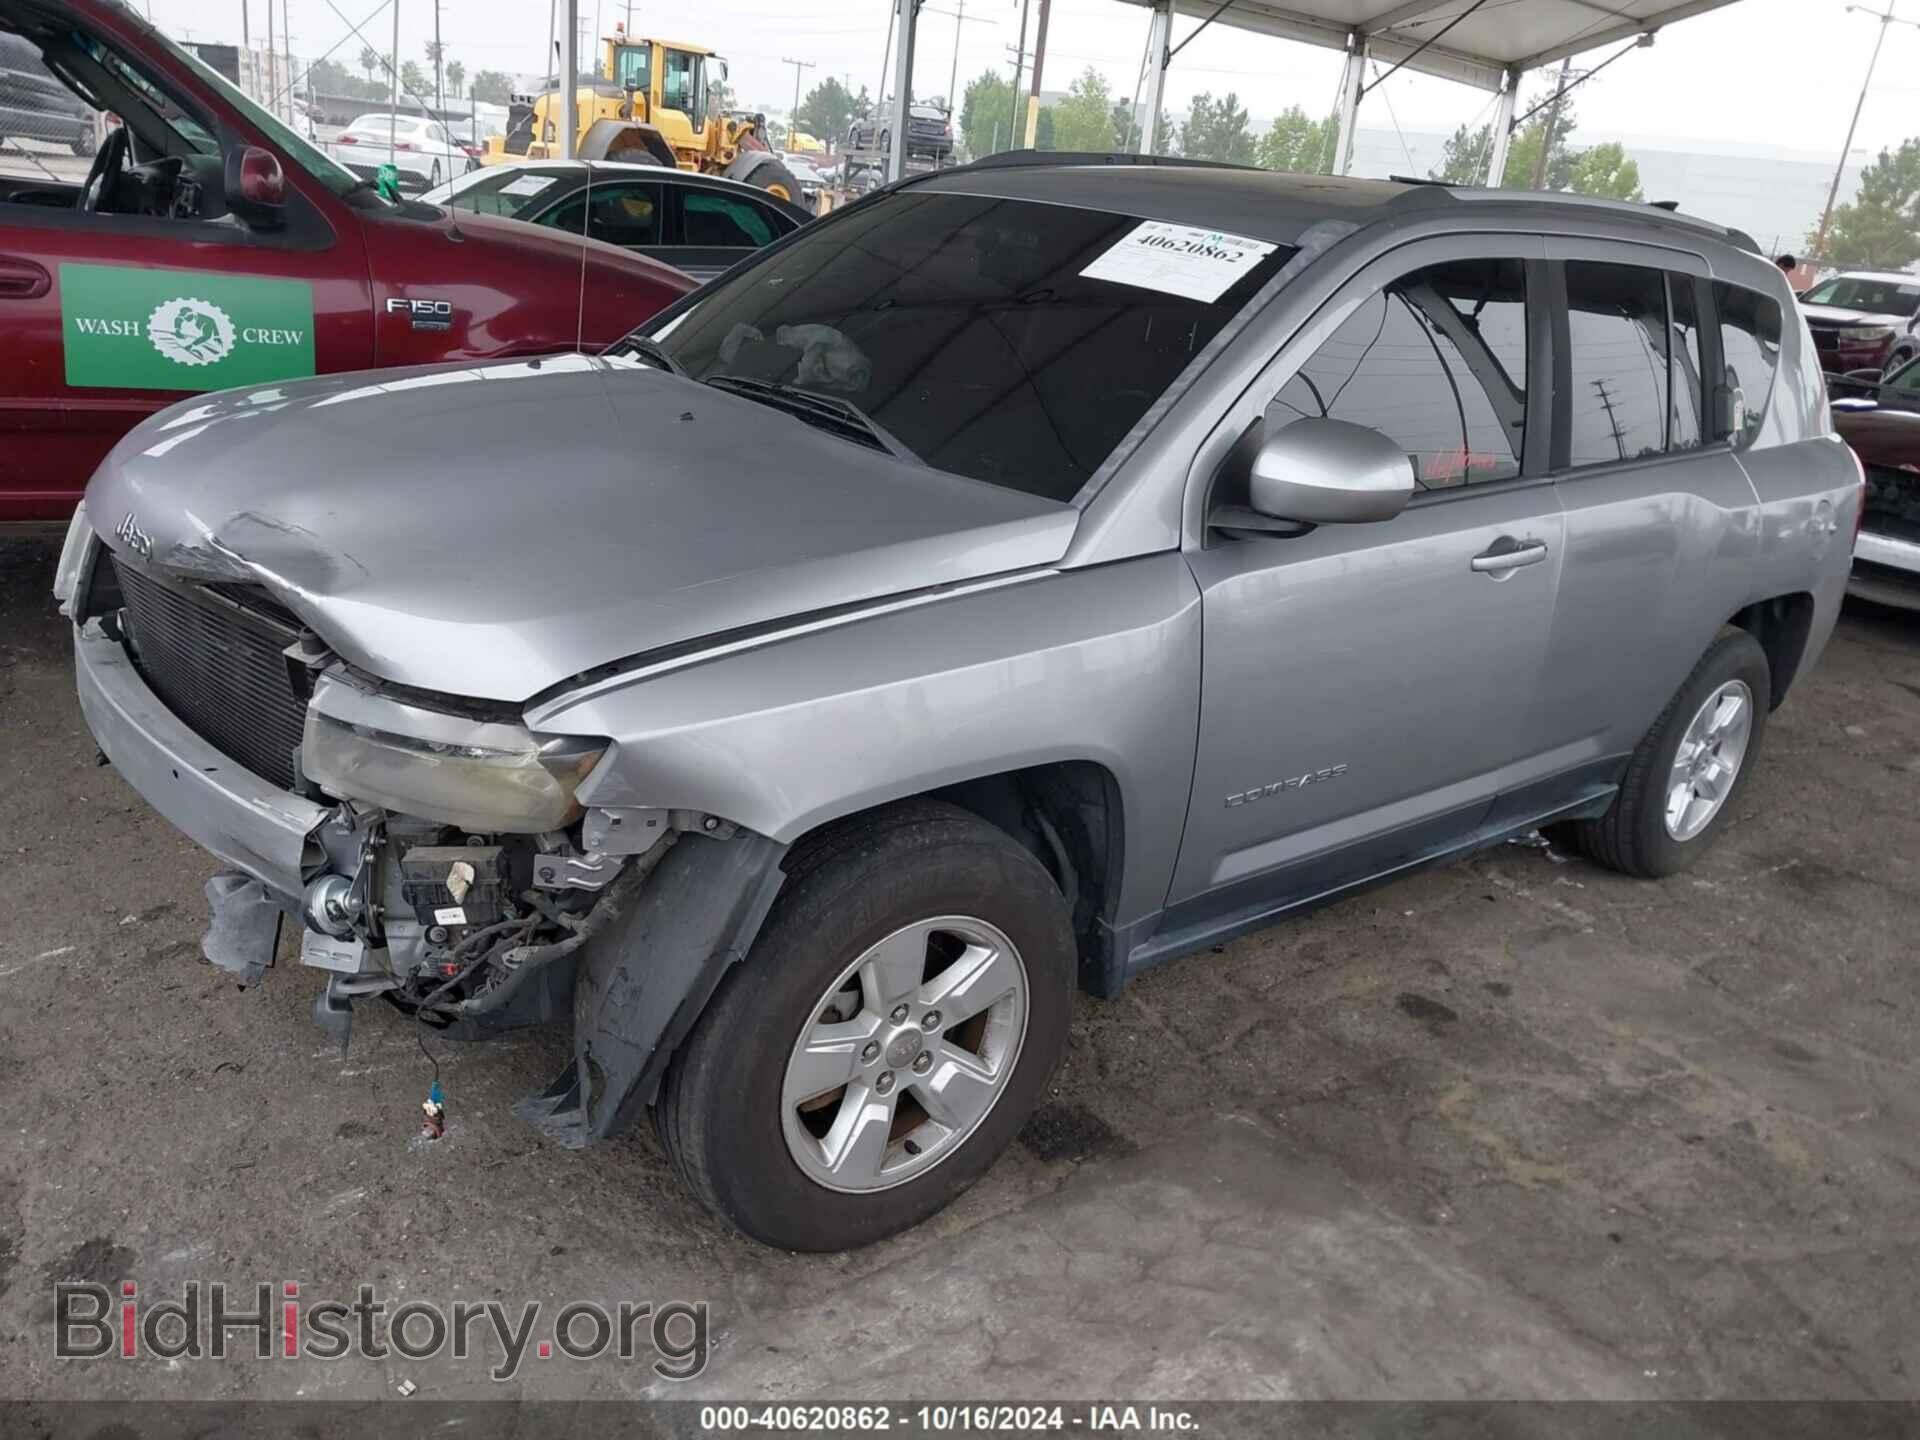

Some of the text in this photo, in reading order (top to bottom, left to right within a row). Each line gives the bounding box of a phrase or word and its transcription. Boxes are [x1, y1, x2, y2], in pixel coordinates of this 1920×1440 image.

[1136, 234, 1244, 263] 40620862
[75, 317, 304, 346] WASH CREW
[1224, 763, 1347, 808] COMPASS
